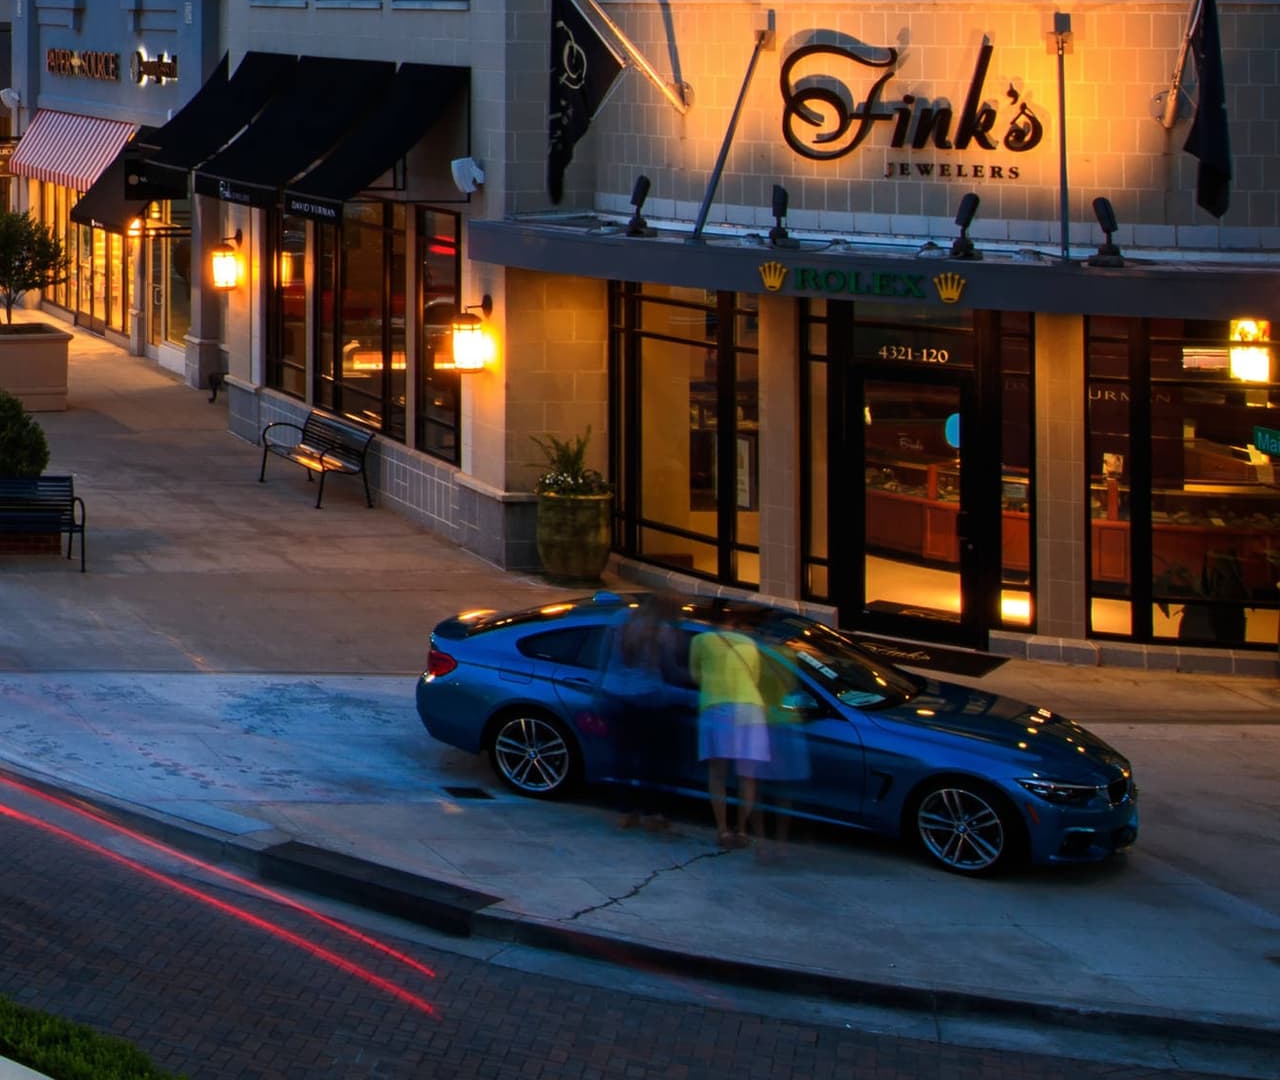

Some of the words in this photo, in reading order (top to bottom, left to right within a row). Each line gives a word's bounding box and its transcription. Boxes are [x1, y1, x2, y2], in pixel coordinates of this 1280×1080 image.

[46, 48, 71, 74] PAPER
[80, 50, 119, 81] SOURCE
[780, 38, 1044, 161] Fink's
[885, 162, 1020, 180] JEWELERS
[794, 267, 928, 298] ROLEX
[877, 345, 949, 364] 4321-120
